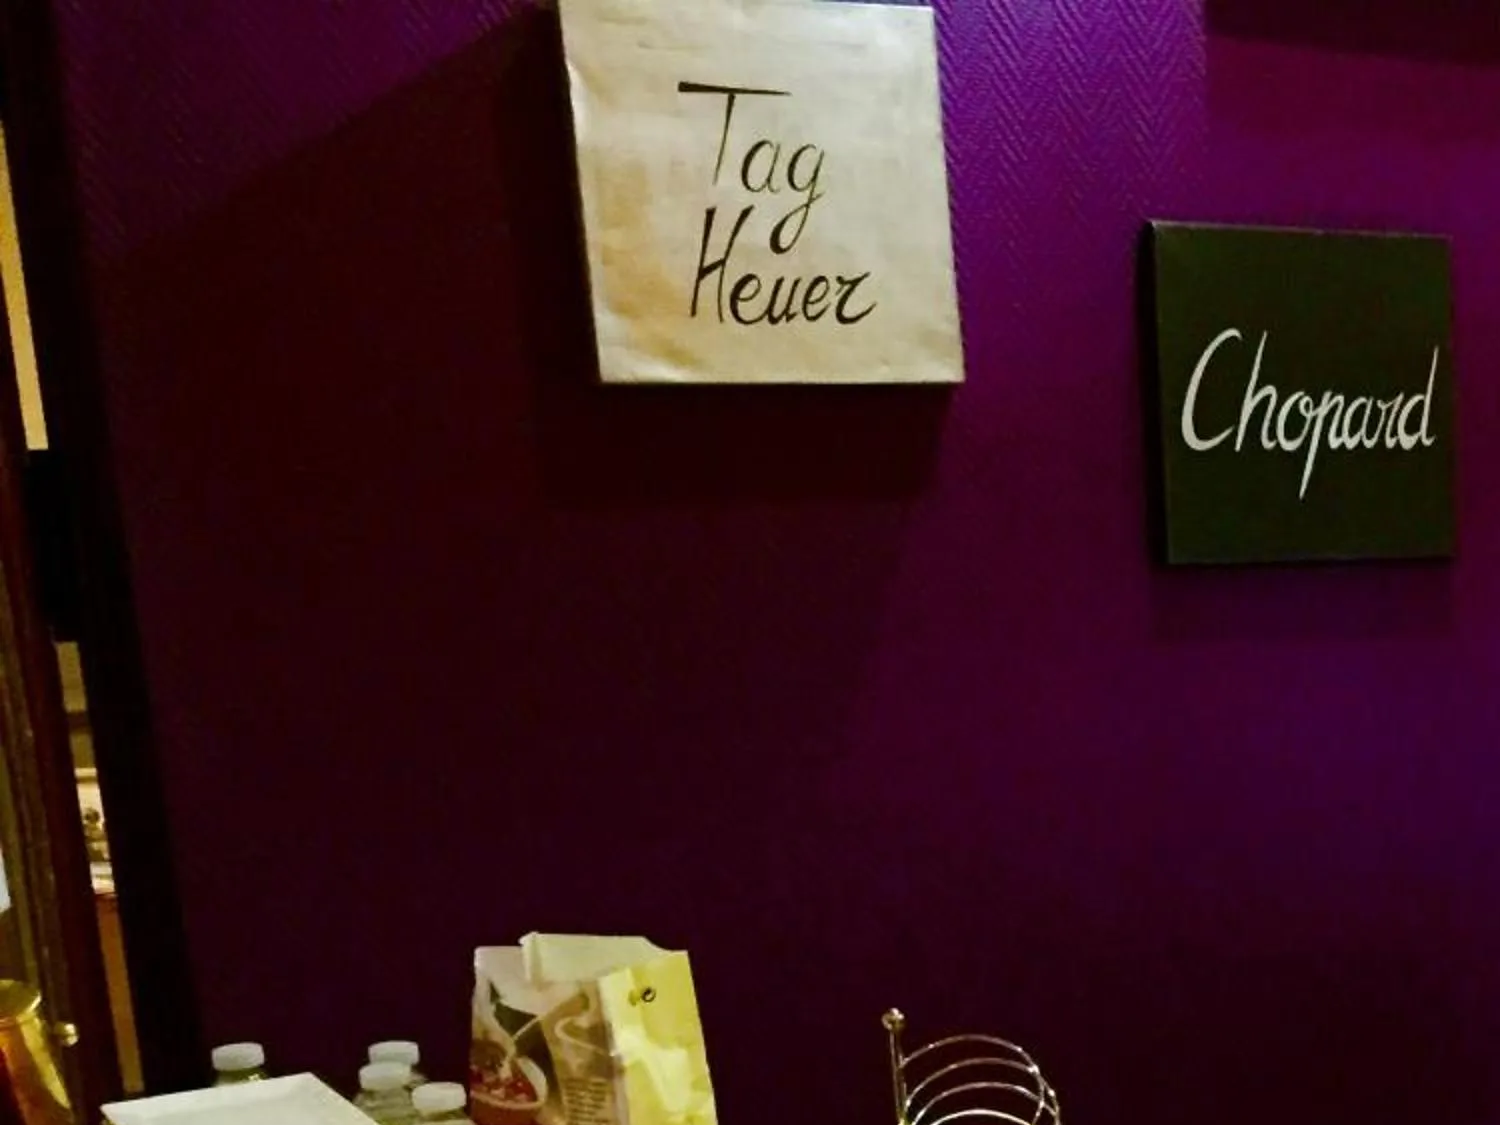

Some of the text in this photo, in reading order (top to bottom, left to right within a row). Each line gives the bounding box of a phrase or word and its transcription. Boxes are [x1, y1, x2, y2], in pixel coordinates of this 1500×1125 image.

[677, 81, 826, 255] Tag
[689, 203, 877, 326] Heuer
[1181, 327, 1439, 501] Chopard
